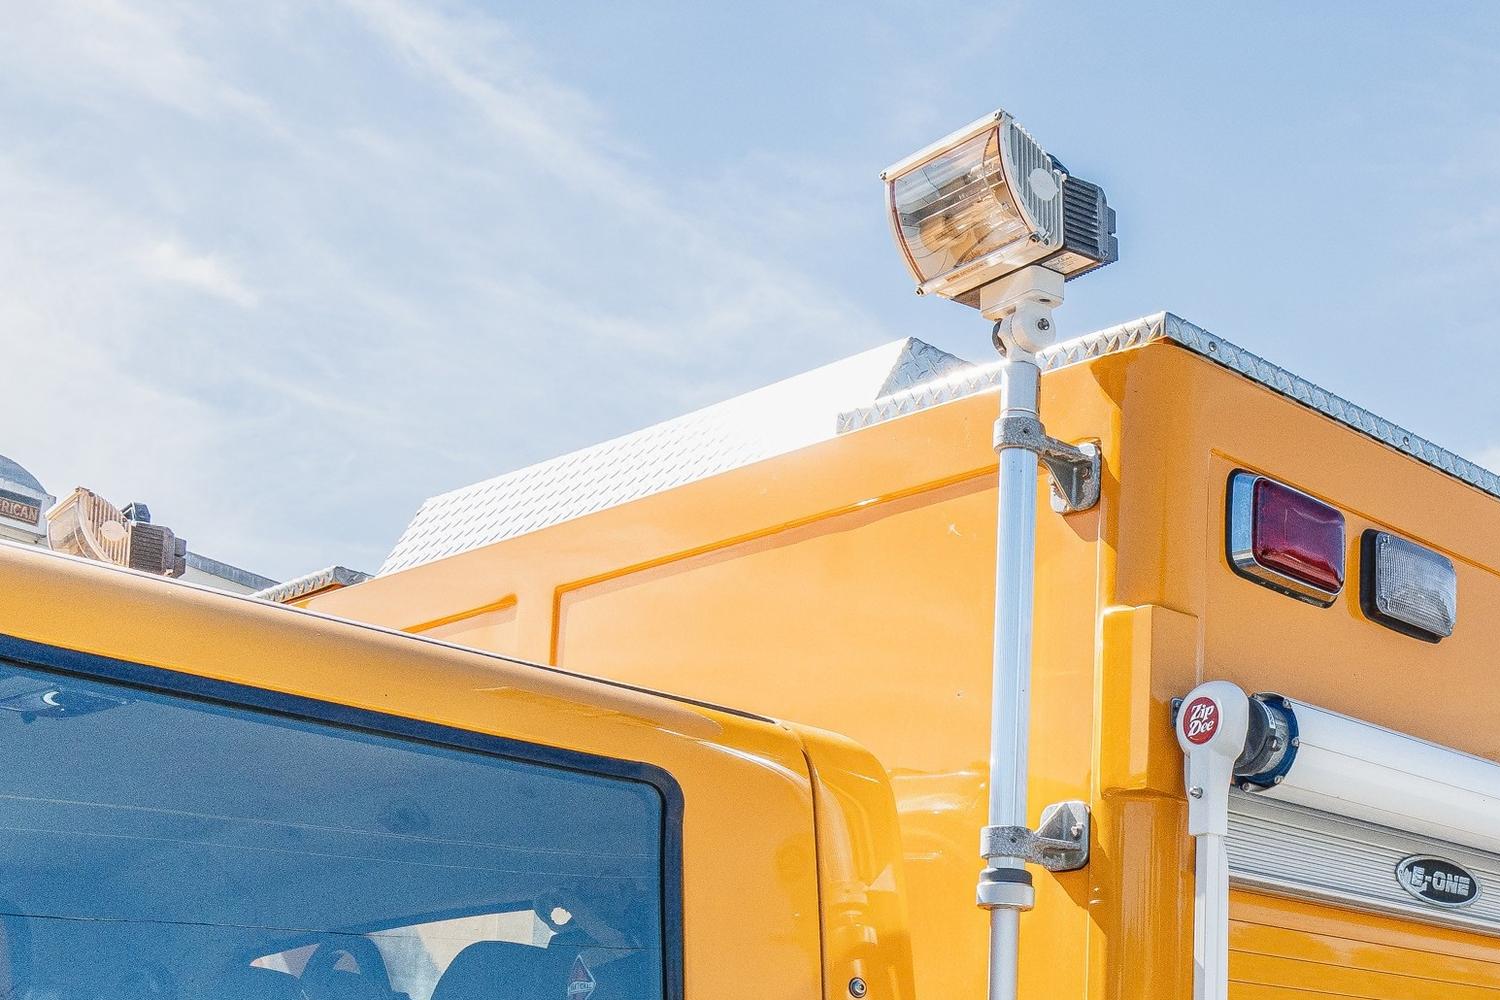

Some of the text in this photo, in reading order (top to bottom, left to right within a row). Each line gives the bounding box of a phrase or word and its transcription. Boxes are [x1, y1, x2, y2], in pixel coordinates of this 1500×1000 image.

[1191, 704, 1214, 722] Zip
[1188, 720, 1214, 737] Dee
[1411, 865, 1470, 897] E-ONE
